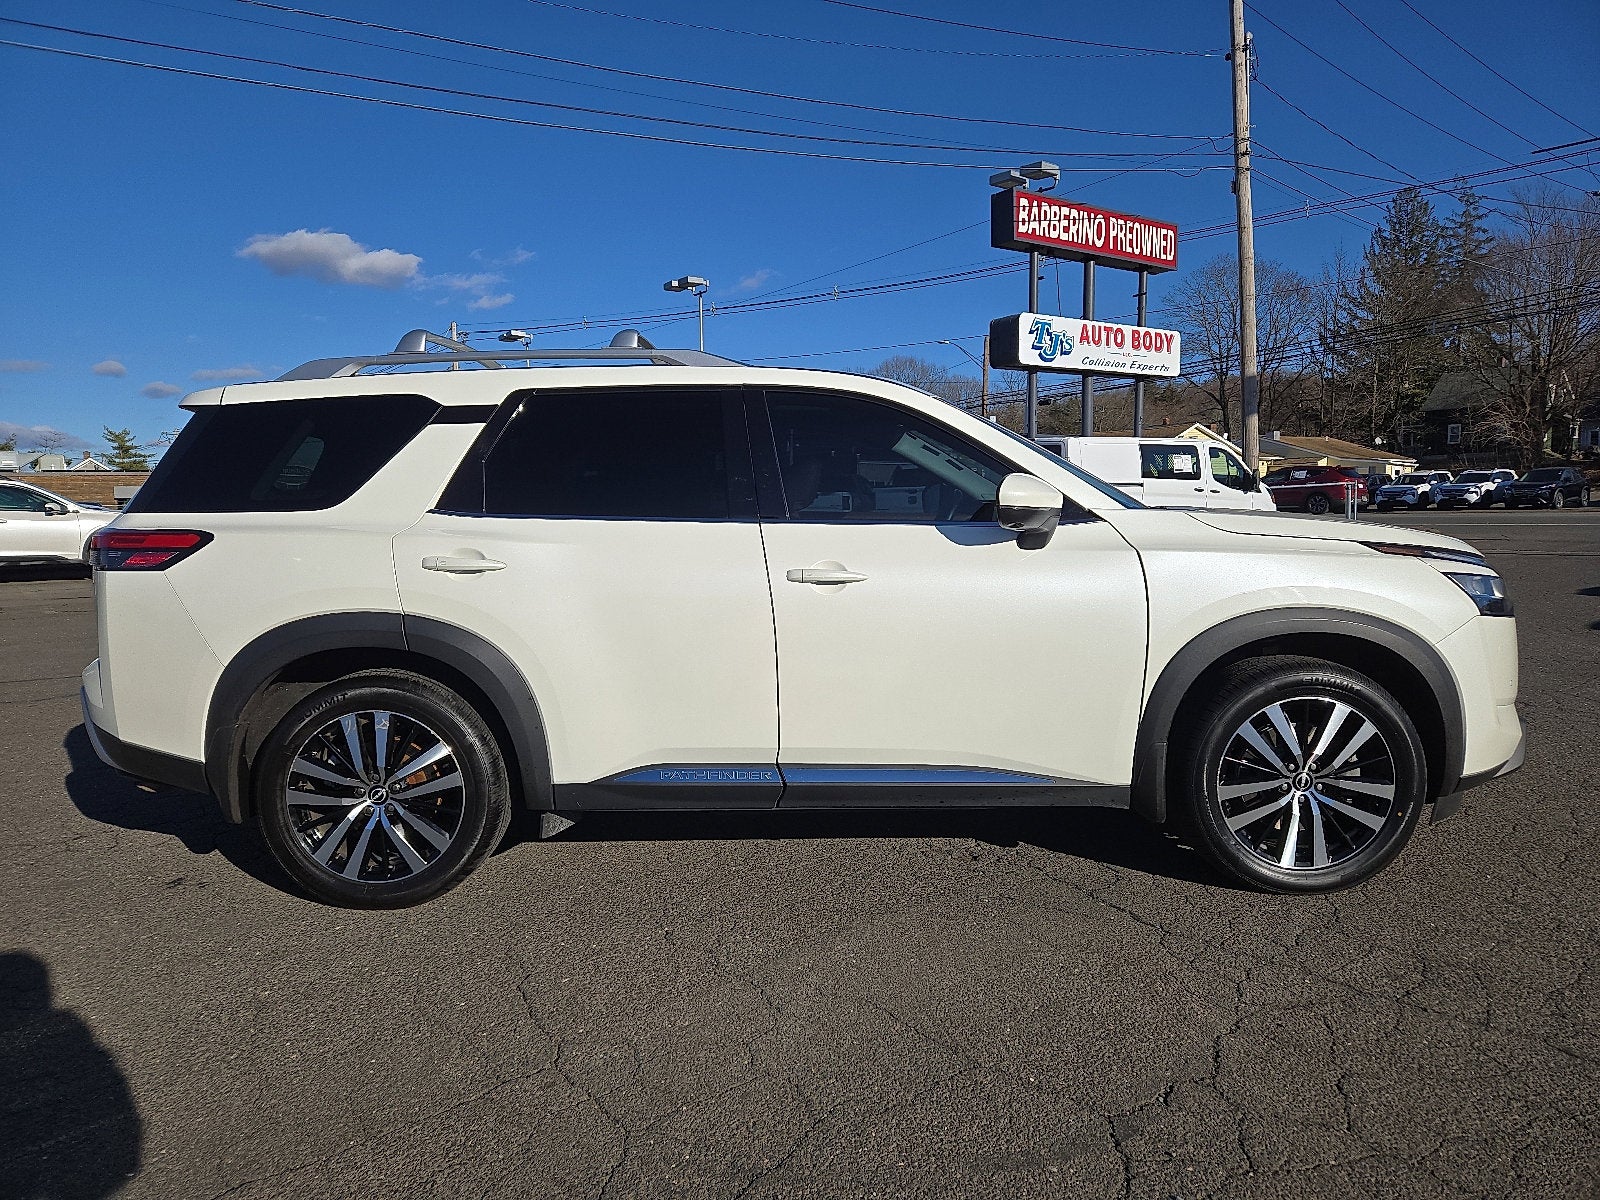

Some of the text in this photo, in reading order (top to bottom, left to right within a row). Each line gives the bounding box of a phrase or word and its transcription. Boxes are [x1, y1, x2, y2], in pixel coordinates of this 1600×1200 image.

[1018, 197, 1175, 261] BARBERINO PREOWNED
[1028, 317, 1074, 363] TJ's
[1079, 323, 1176, 354] AUTO BODY
[1081, 356, 1172, 372] Collision Experts
[660, 770, 773, 780] PATHFINDER
